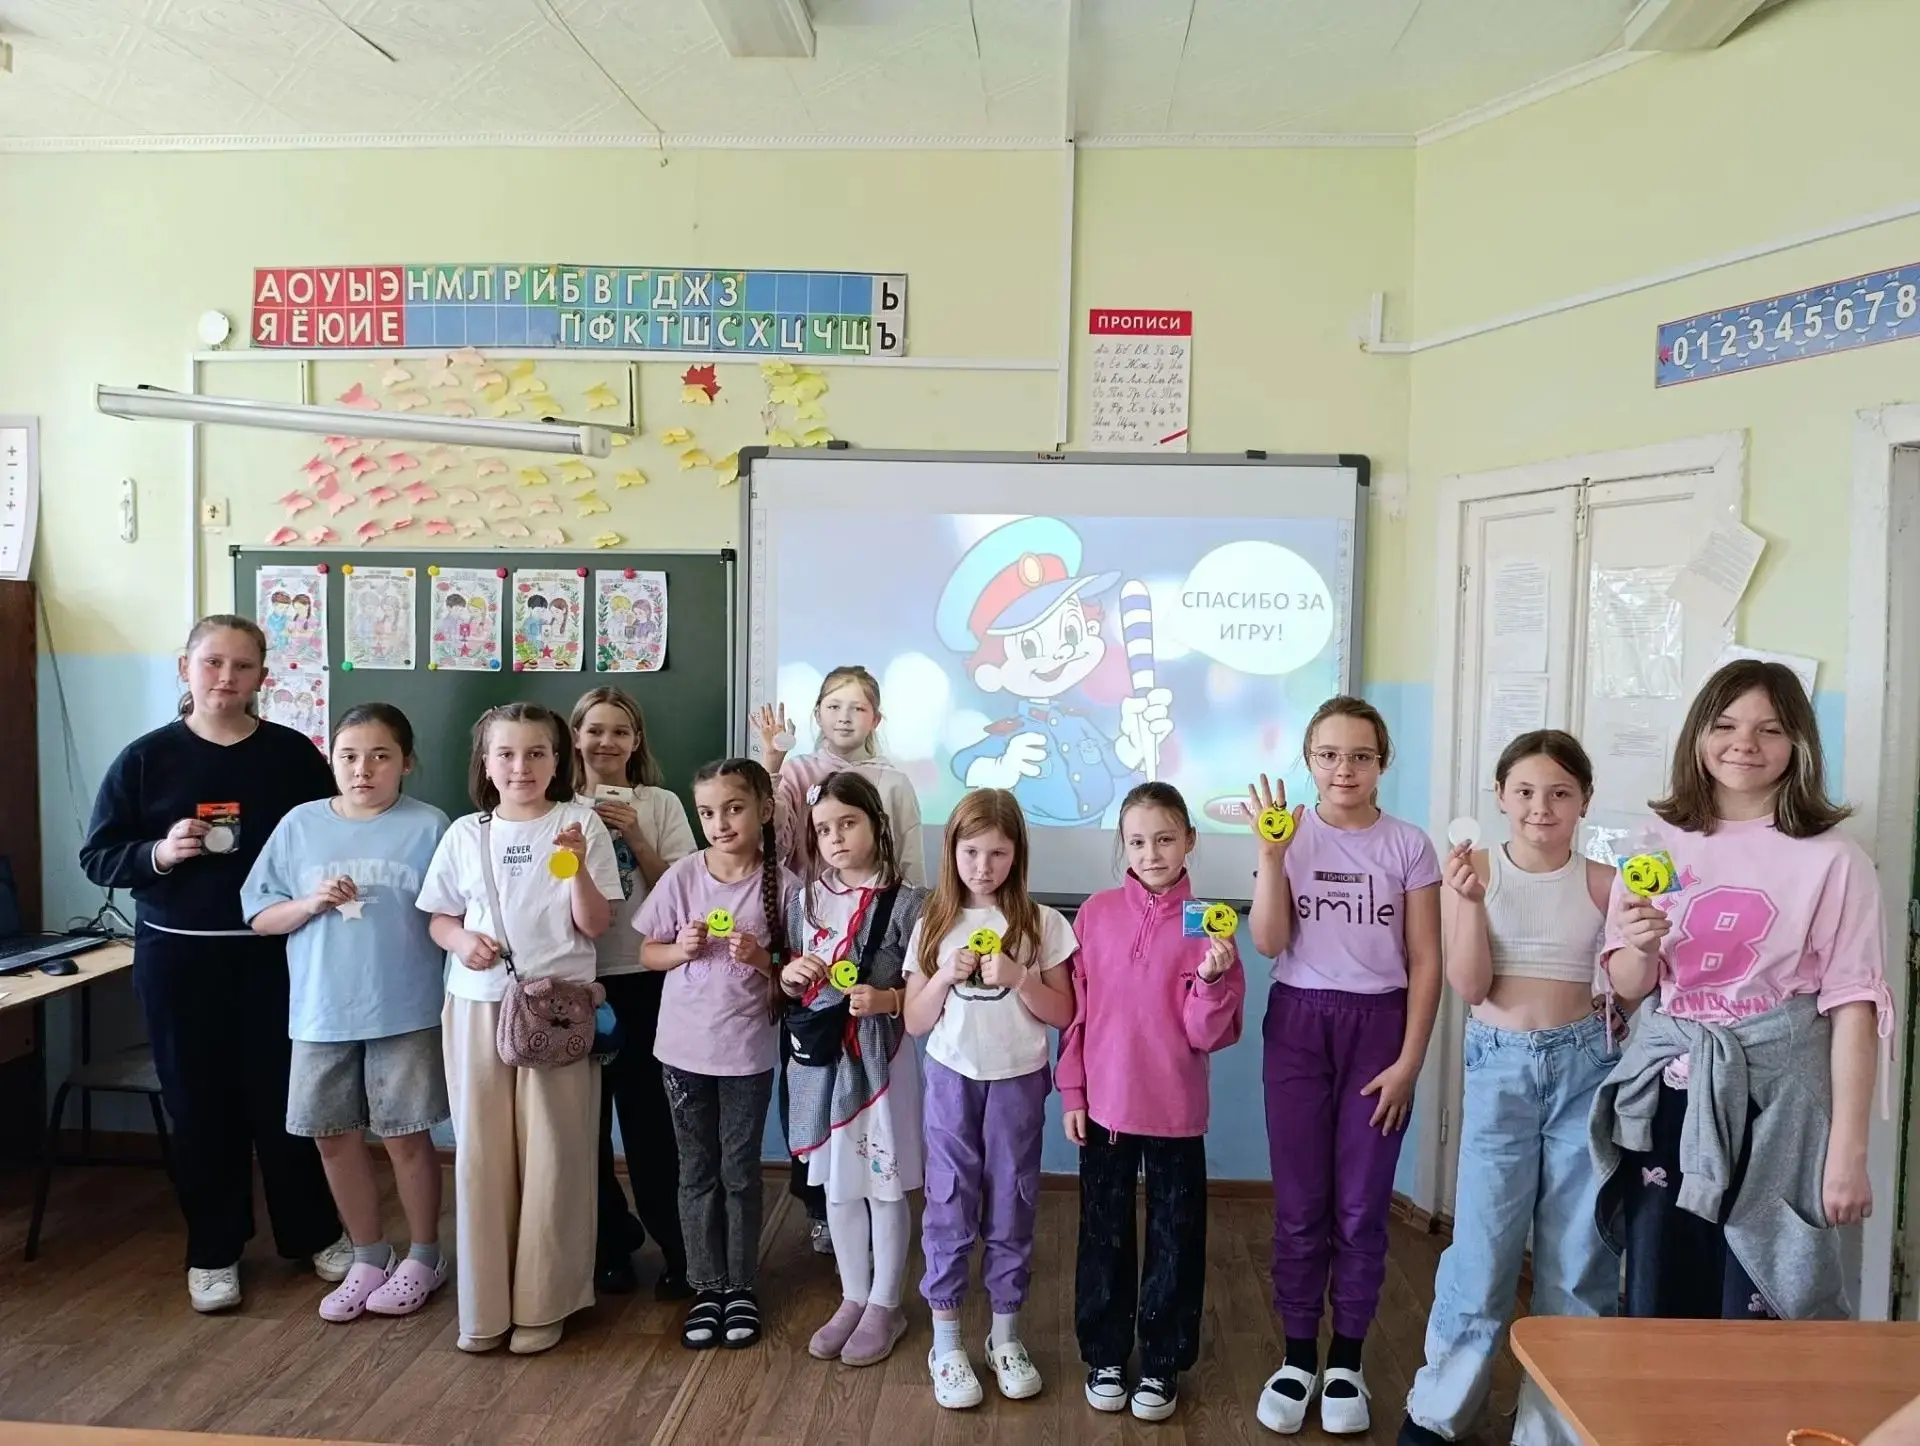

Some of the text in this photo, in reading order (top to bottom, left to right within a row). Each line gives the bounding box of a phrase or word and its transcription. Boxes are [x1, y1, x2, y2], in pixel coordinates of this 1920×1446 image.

[1098, 316, 1180, 329] ПРОПИСИ
[1182, 591, 1325, 610] СПАСИБО ЗА
[1220, 623, 1282, 641] ИГРУ!
[1220, 803, 1257, 816] МЕ
[506, 845, 531, 854] NEVER
[503, 854, 532, 864] ENOUGH
[1298, 874, 1395, 926] smile
